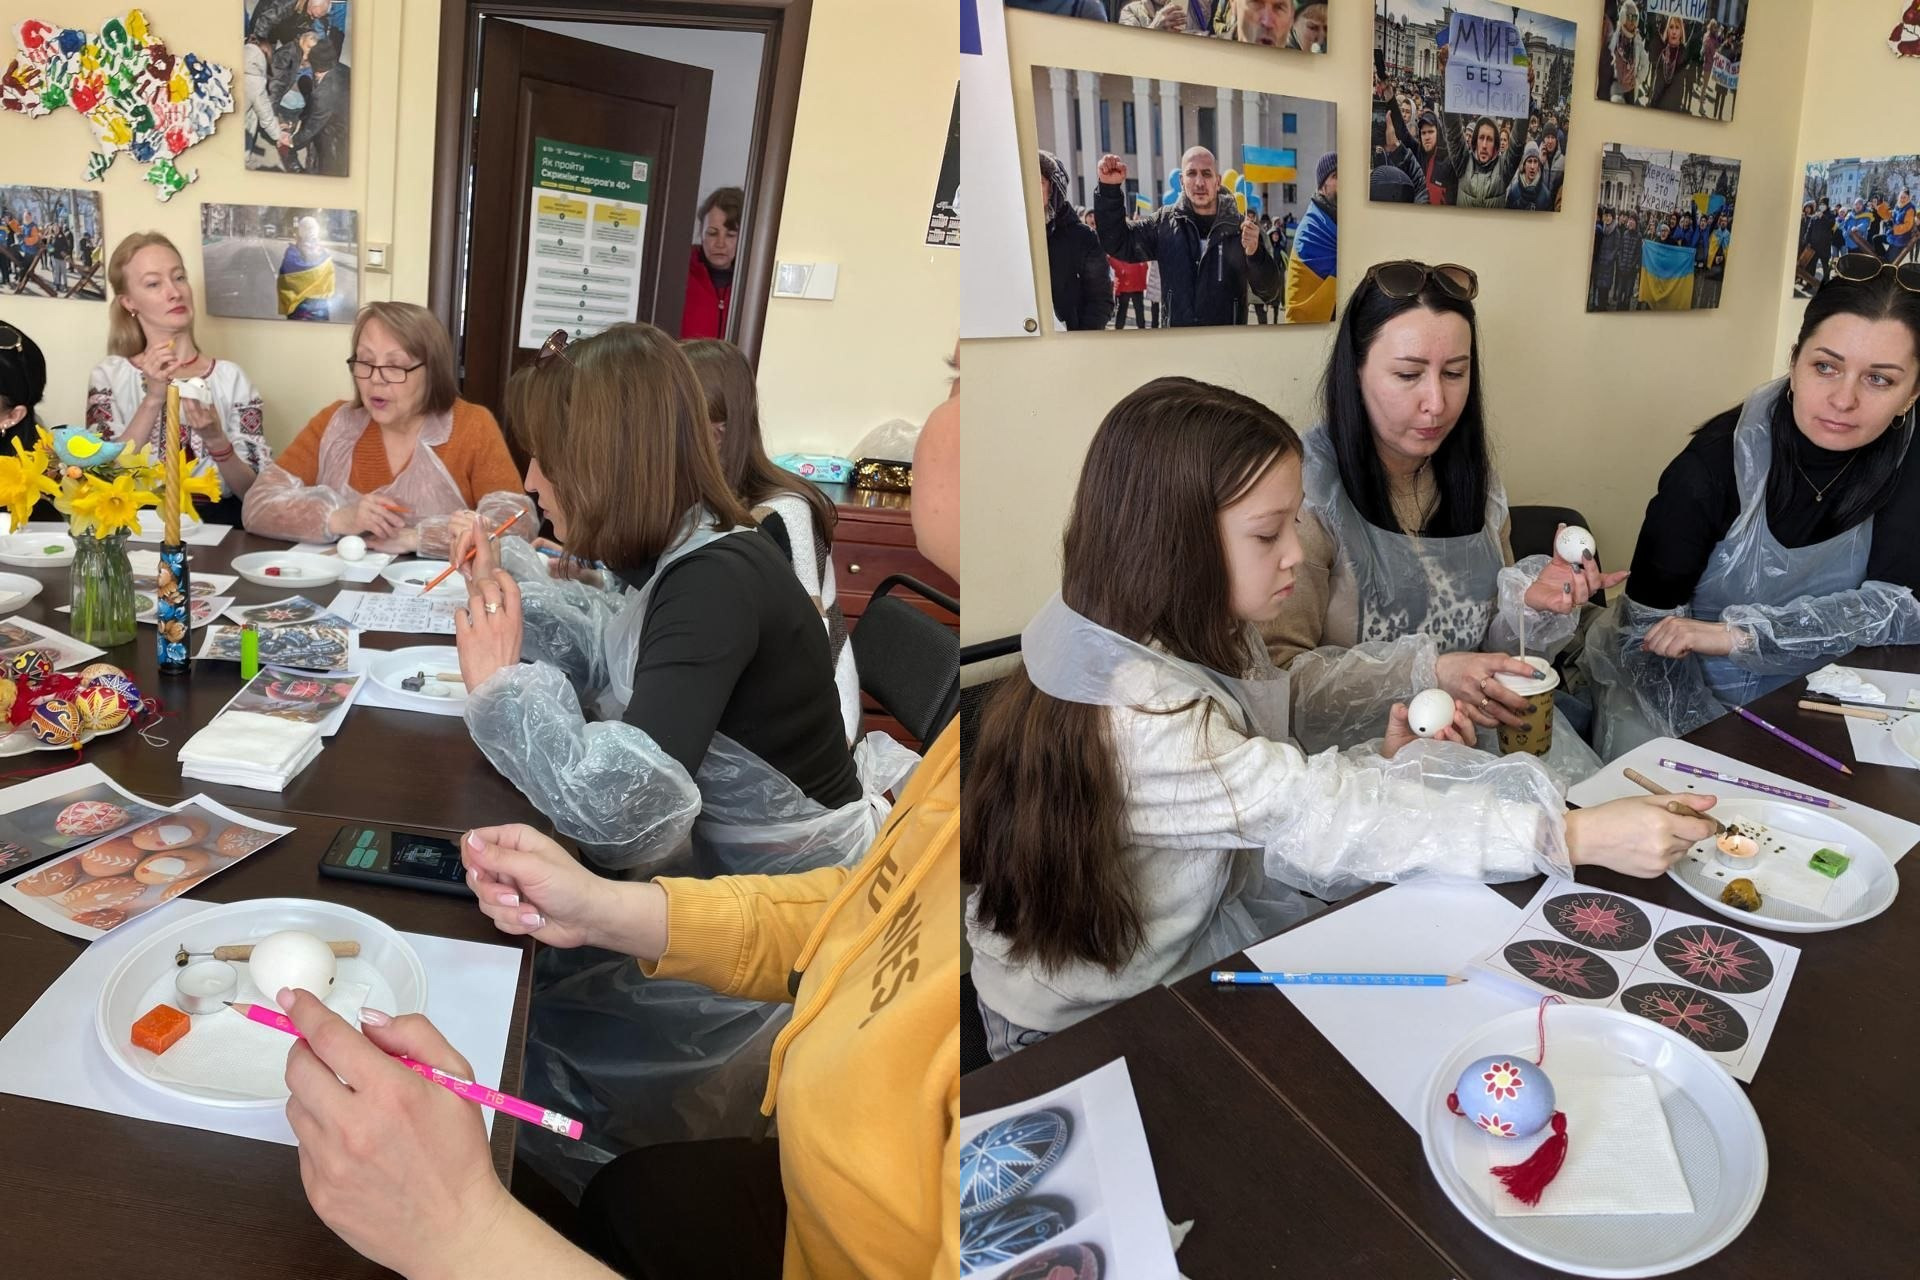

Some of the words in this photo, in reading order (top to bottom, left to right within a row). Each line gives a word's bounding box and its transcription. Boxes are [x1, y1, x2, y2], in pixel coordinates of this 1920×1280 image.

[1466, 65, 1503, 86] БЕЗ
[542, 157, 553, 167] Як
[554, 160, 585, 172] пройти
[541, 168, 579, 183] Скринінг
[580, 176, 615, 188] здоров'я
[615, 180, 631, 190] 40+
[486, 1091, 505, 1105] HB
